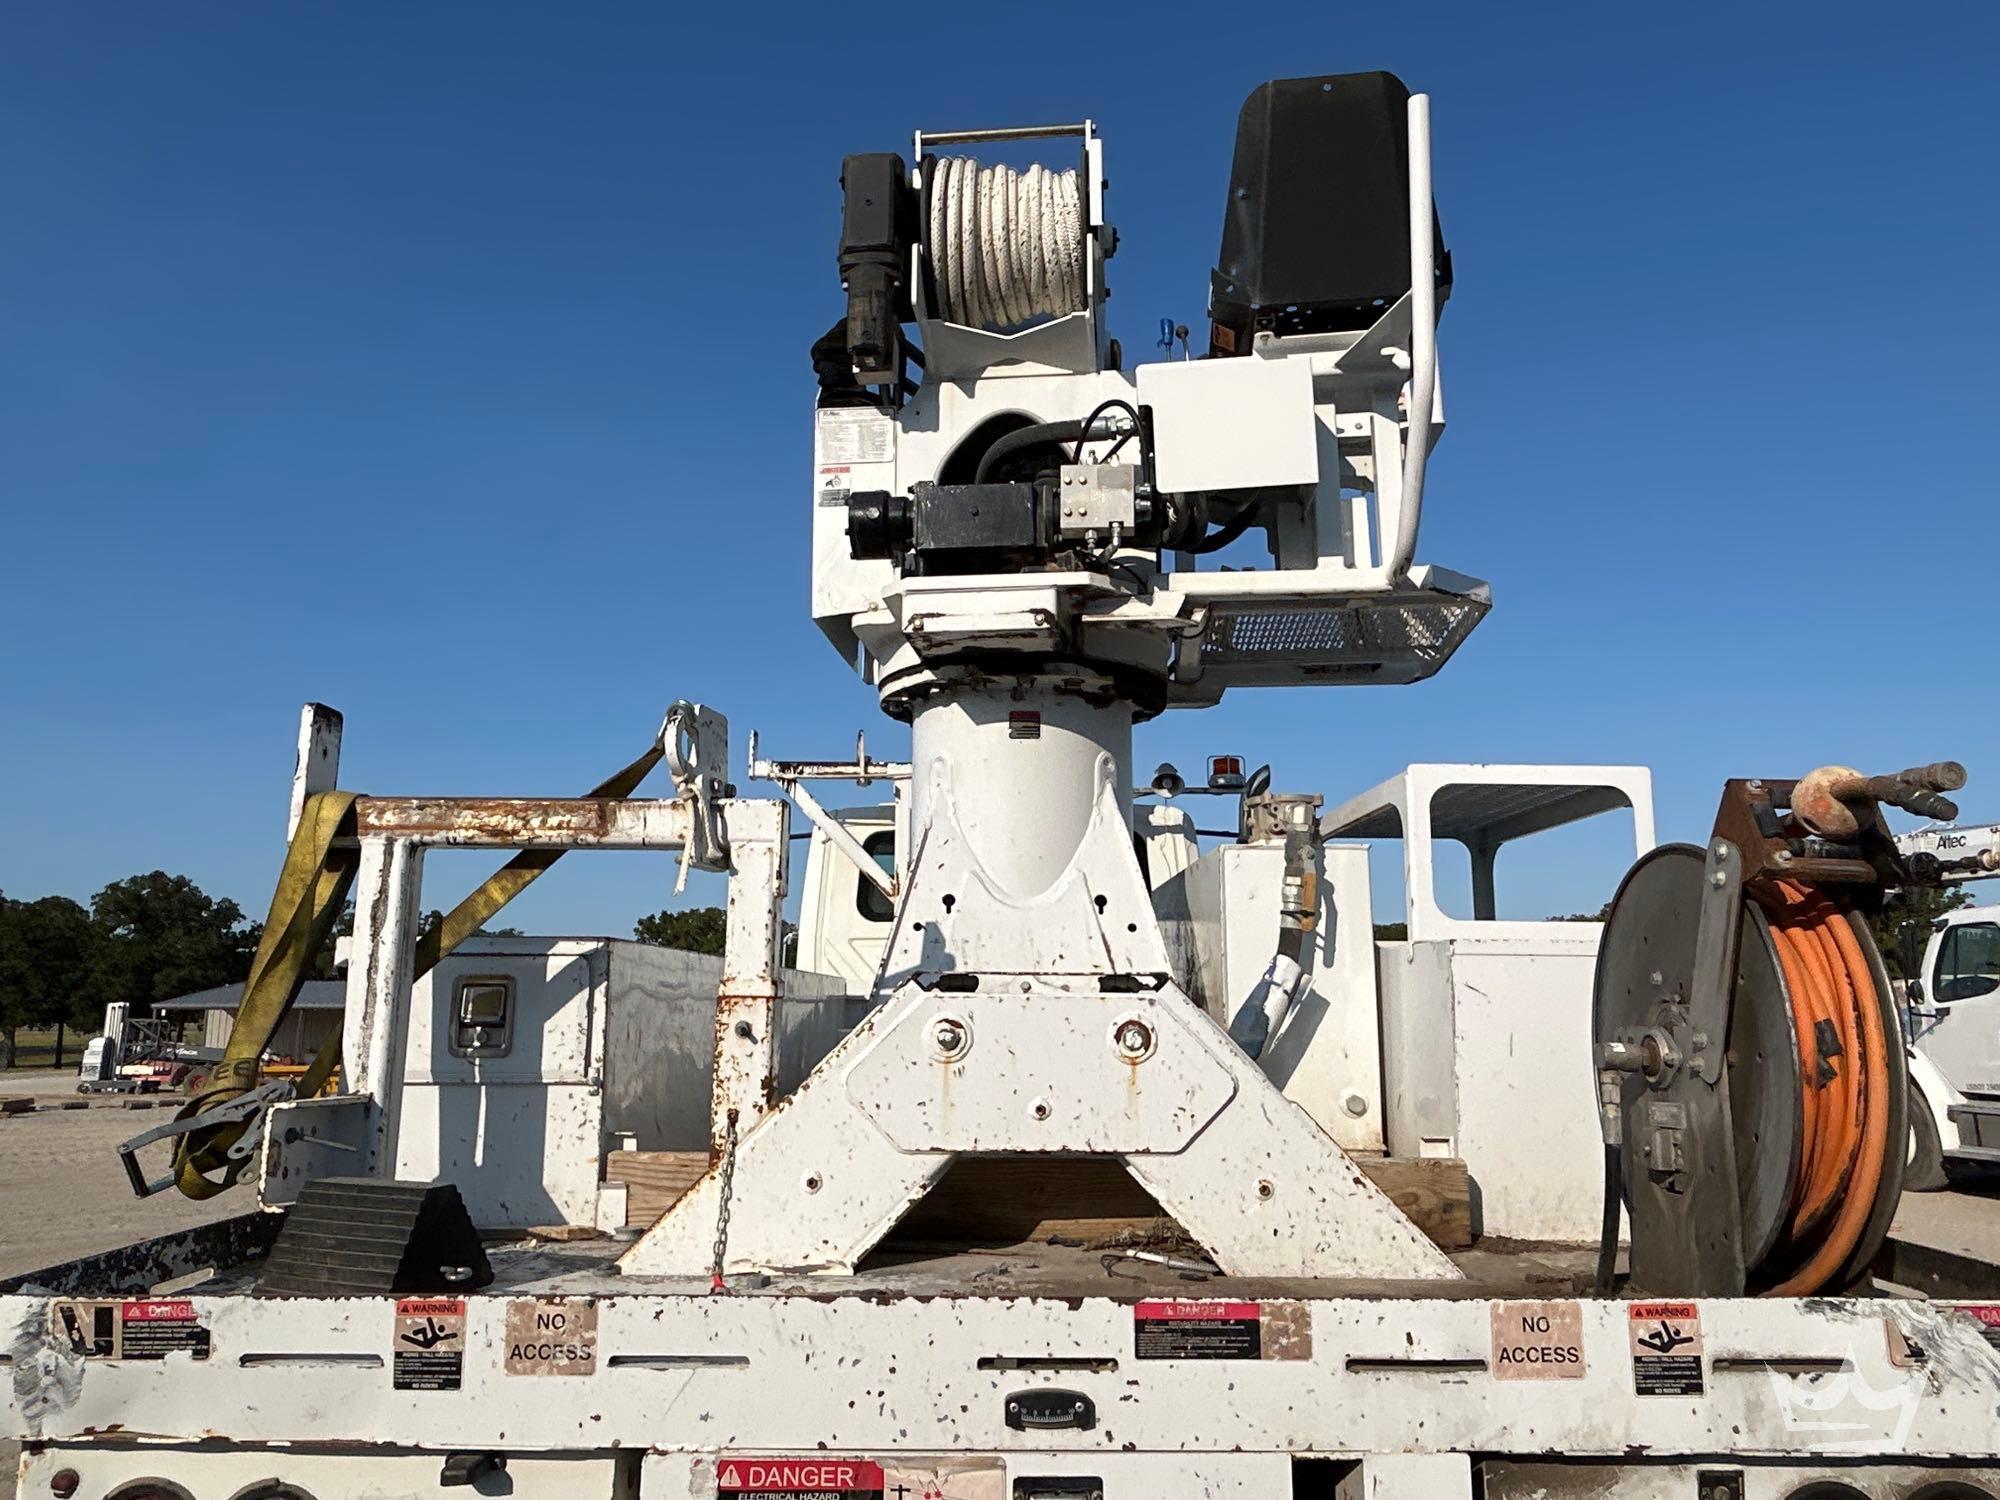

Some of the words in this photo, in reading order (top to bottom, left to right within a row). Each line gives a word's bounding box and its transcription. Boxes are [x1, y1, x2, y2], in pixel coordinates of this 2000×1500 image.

[1936, 835, 1967, 850] Altec
[411, 1303, 457, 1314] WARNING
[1176, 1304, 1226, 1316] DANGER
[1645, 1307, 1690, 1318] WARNING
[537, 1313, 566, 1330] NO
[1522, 1316, 1551, 1333] NO
[509, 1343, 592, 1361] ACCESS
[1499, 1346, 1580, 1363] ACCESS
[749, 1467, 854, 1487] DANGER
[738, 1492, 797, 1500] ELECTRICAL
[800, 1492, 840, 1500] HAZARD
